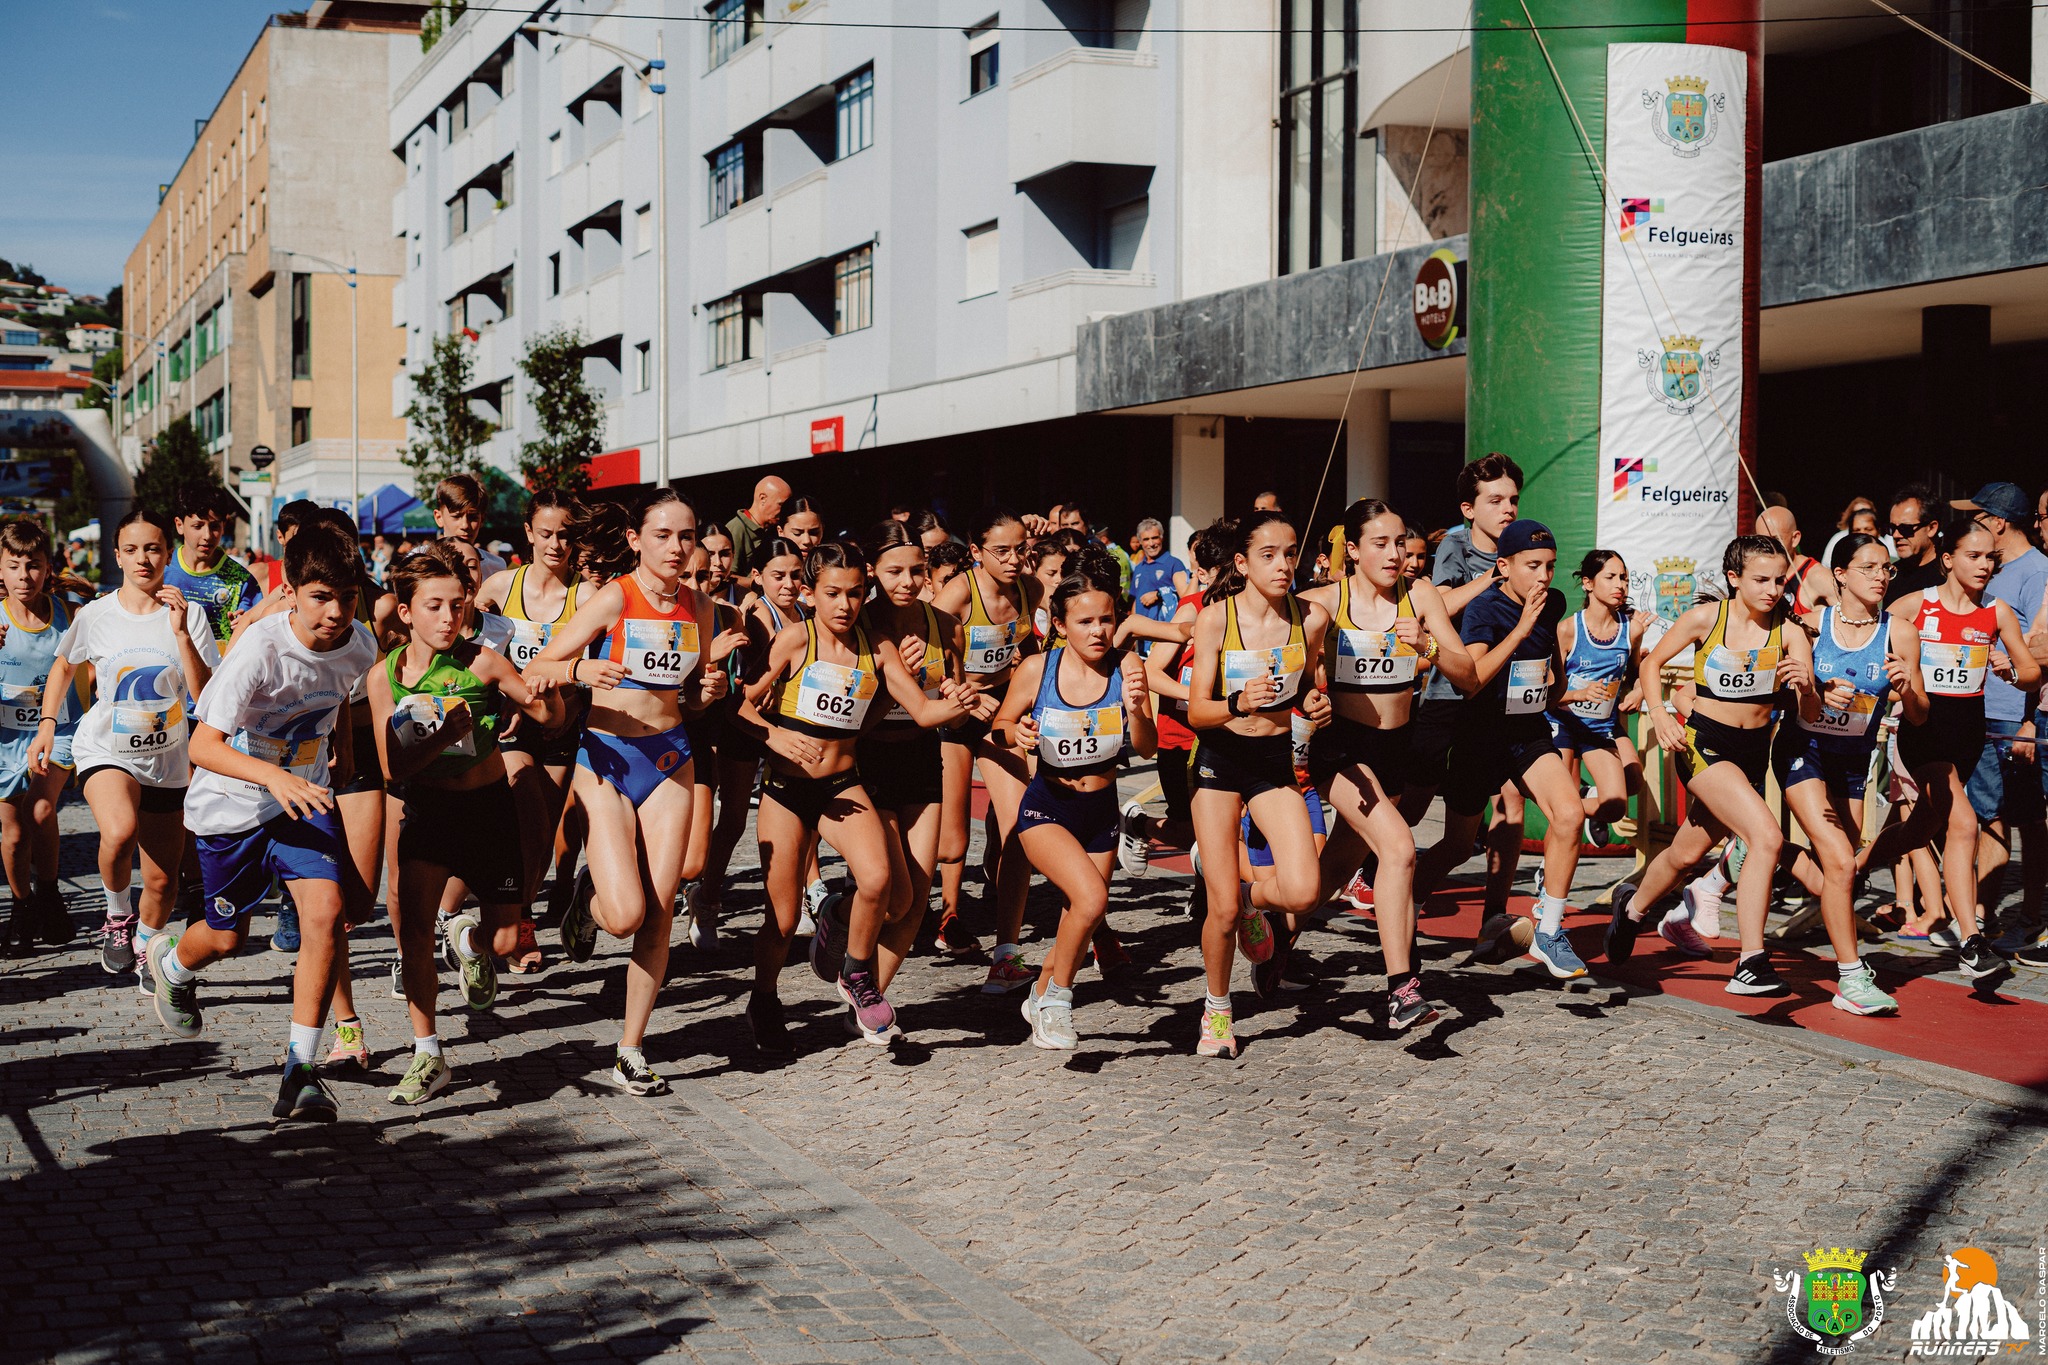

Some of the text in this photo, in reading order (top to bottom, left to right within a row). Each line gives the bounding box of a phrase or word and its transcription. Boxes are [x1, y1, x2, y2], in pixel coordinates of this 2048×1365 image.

[1648, 226, 1734, 247] Felgueiras
[1415, 278, 1452, 314] B&B
[1420, 311, 1447, 326] HOTELS
[1642, 485, 1729, 506] Felgueiras
[517, 645, 540, 660] 66
[983, 645, 1015, 664] 667
[643, 651, 682, 672] 642
[1354, 658, 1395, 674] 670
[1719, 673, 1755, 688] 663
[1933, 668, 1968, 684] 615
[816, 692, 855, 717] 662
[15, 708, 43, 722] 62
[813, 711, 835, 721] LEONOR
[412, 720, 437, 737] 61
[129, 731, 168, 748] 640
[236, 739, 281, 756] Felgueiras
[238, 733, 271, 748] Corrida
[1058, 737, 1098, 756] 613
[244, 784, 262, 792] DINIS
